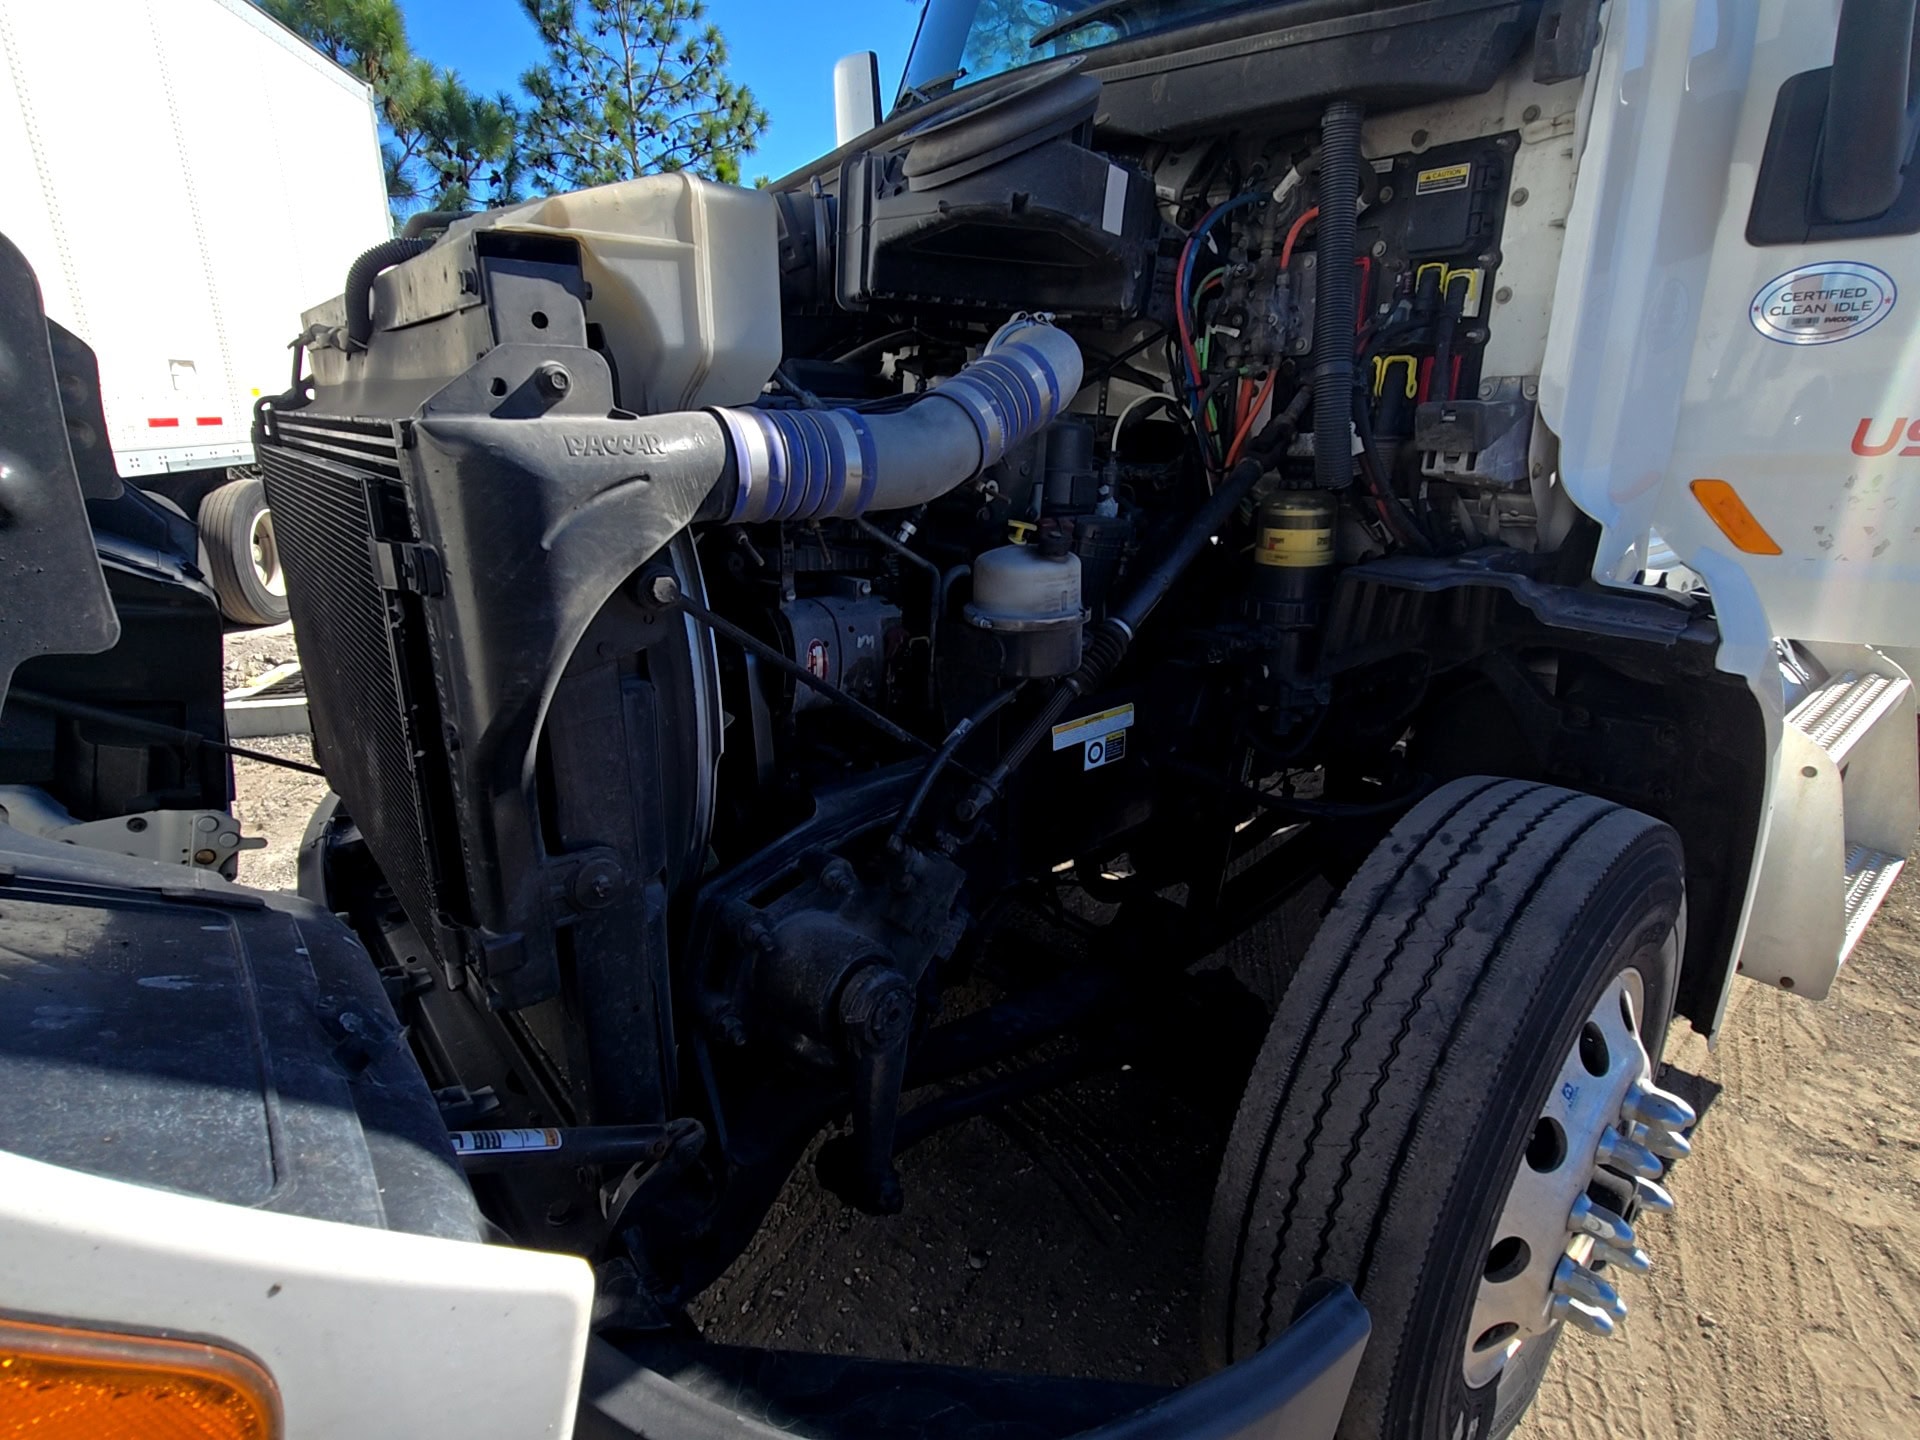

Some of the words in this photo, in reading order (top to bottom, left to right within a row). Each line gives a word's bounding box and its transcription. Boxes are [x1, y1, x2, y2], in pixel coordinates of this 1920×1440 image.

[1432, 168, 1462, 179] CAUTION
[1780, 287, 1867, 302] CERTIFIED
[1770, 303, 1827, 316] CLEAN
[1834, 300, 1873, 312] IDLE
[563, 433, 668, 457] PACCAR
